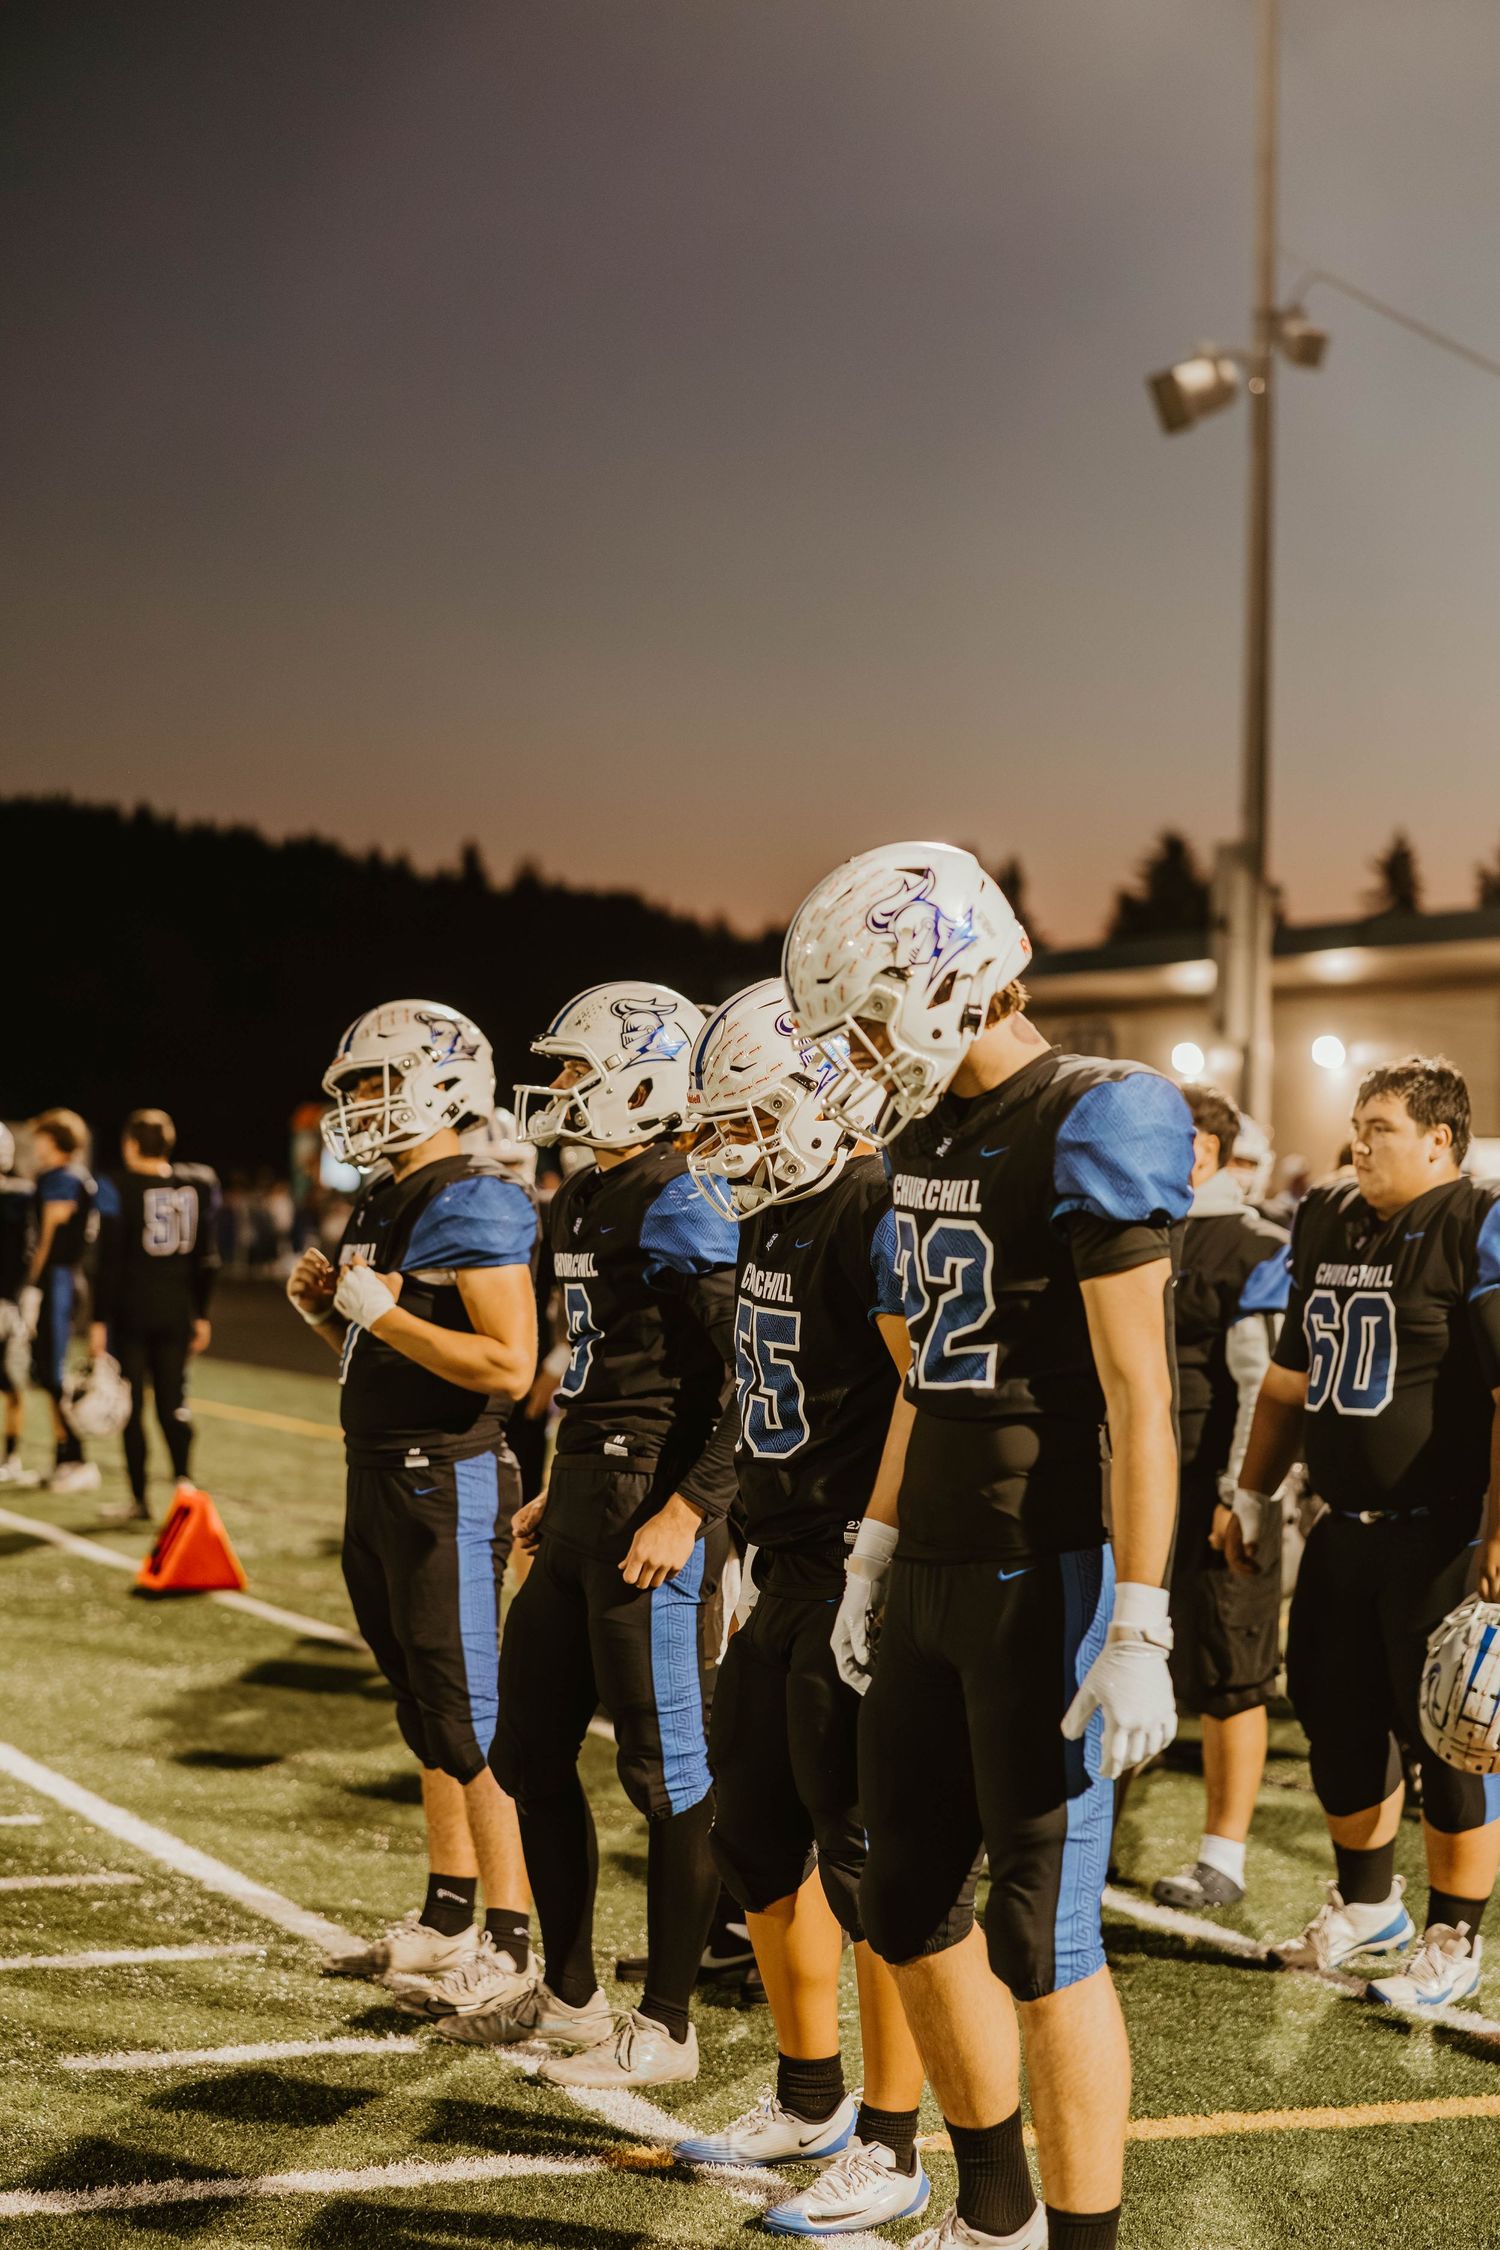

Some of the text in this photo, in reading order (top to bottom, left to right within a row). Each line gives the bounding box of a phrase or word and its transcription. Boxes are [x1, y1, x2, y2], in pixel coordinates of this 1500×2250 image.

[893, 1173, 982, 1213] CHURCHILL
[1314, 1262, 1394, 1288] CHURCHILL
[1302, 1289, 1398, 1417] 60
